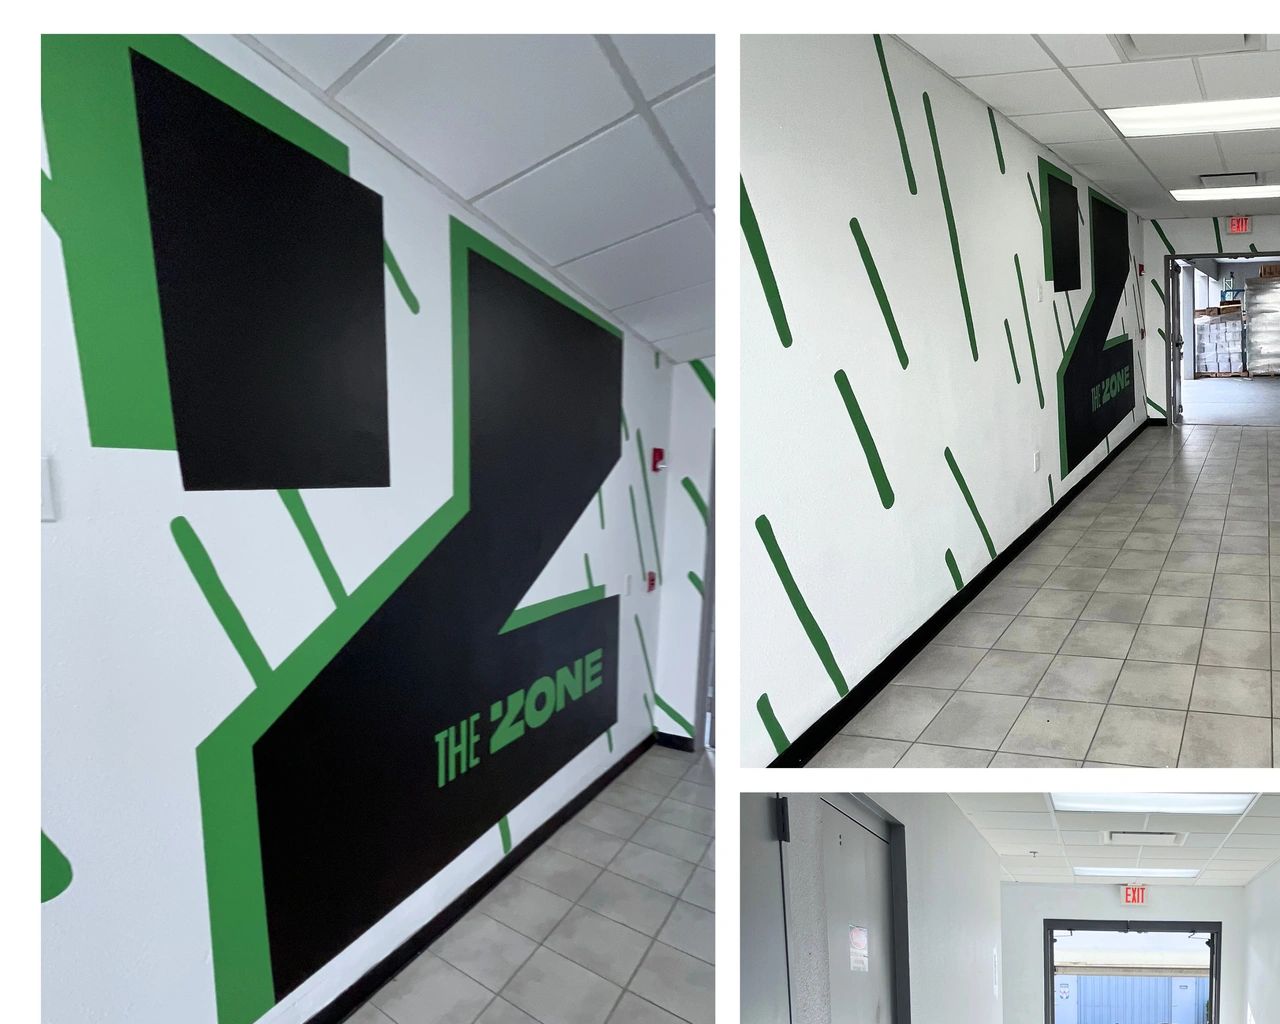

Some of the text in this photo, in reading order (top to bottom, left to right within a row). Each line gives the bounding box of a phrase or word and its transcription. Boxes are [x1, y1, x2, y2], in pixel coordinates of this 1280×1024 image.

[1231, 217, 1248, 232] EXIT
[1091, 365, 1130, 413] THE ZONE
[434, 648, 603, 789] THE ZONE
[1125, 887, 1145, 903] EXIT
